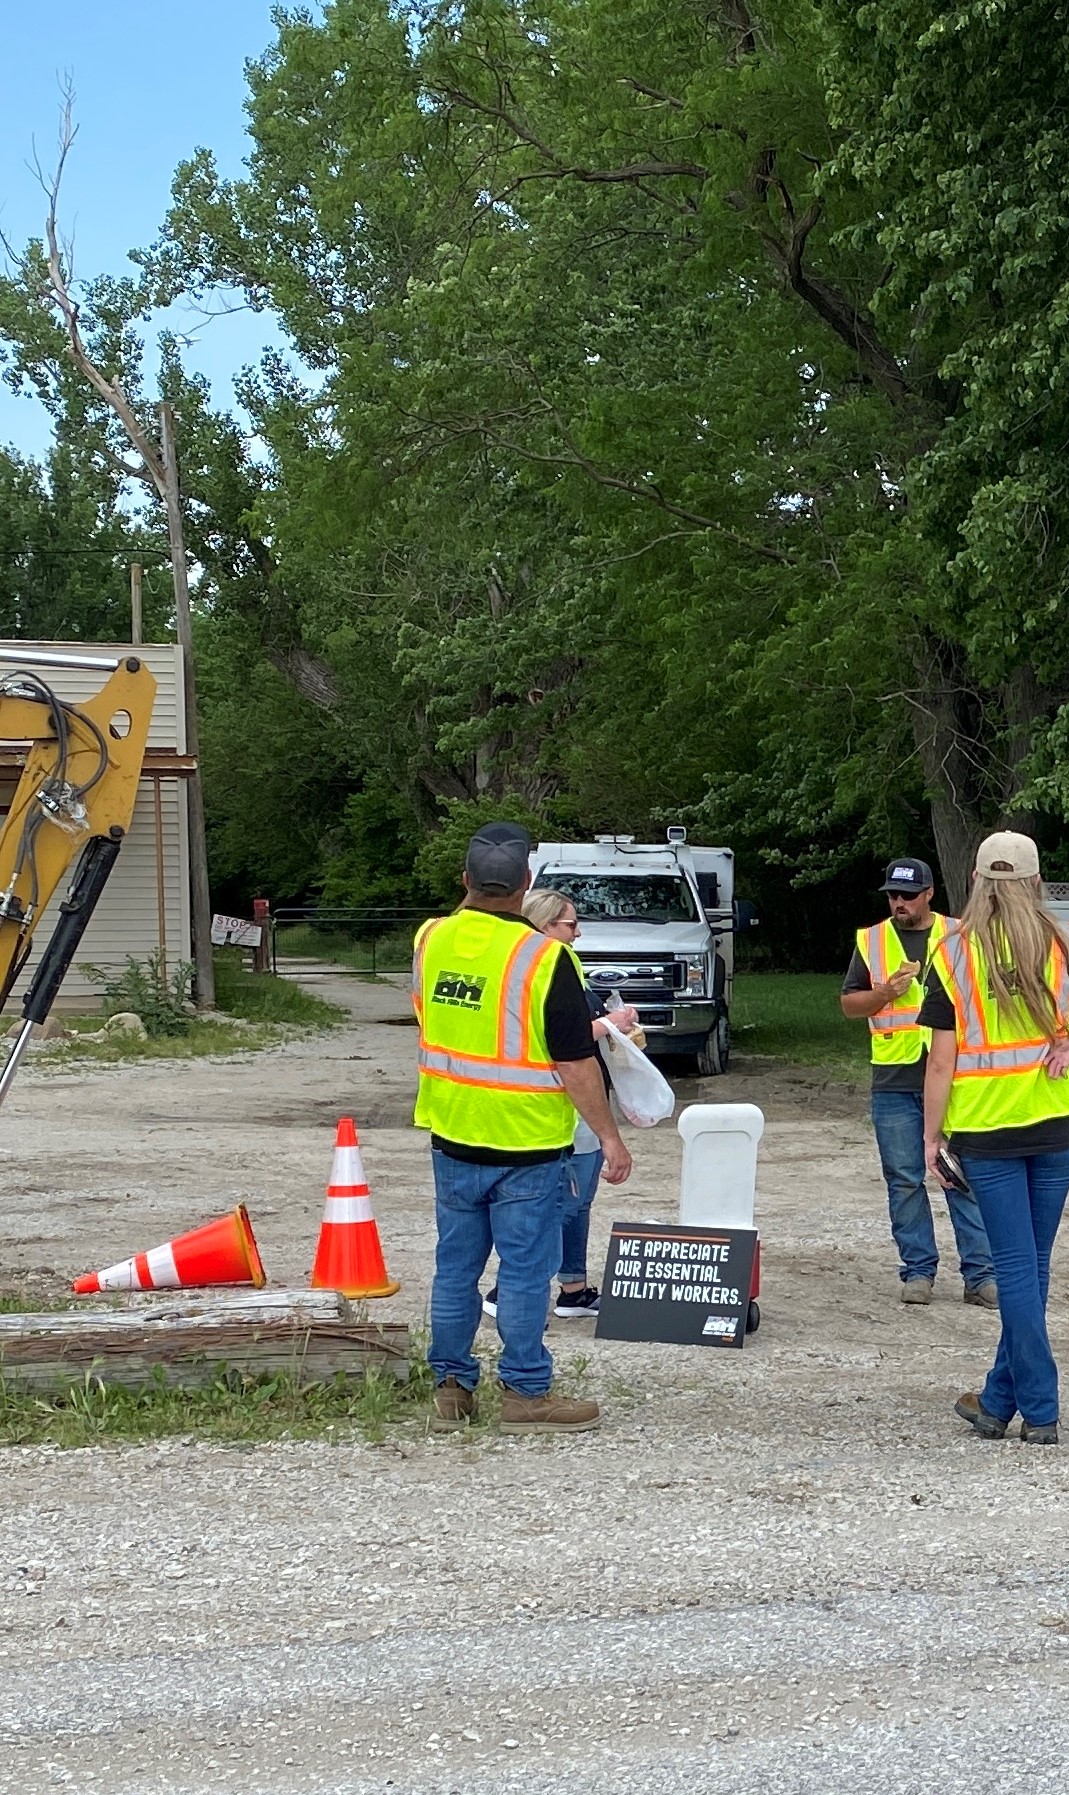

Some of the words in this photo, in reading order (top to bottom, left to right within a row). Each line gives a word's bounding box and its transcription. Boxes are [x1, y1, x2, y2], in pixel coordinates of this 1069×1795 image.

[216, 916, 246, 928] STOP
[619, 1239, 642, 1257] WE
[643, 1241, 730, 1262] APPRECIATE
[614, 1259, 642, 1278] OUR
[644, 1261, 722, 1283] ESSENTIAL
[611, 1280, 667, 1300] UTILITY
[671, 1283, 743, 1306] WORKERS.
